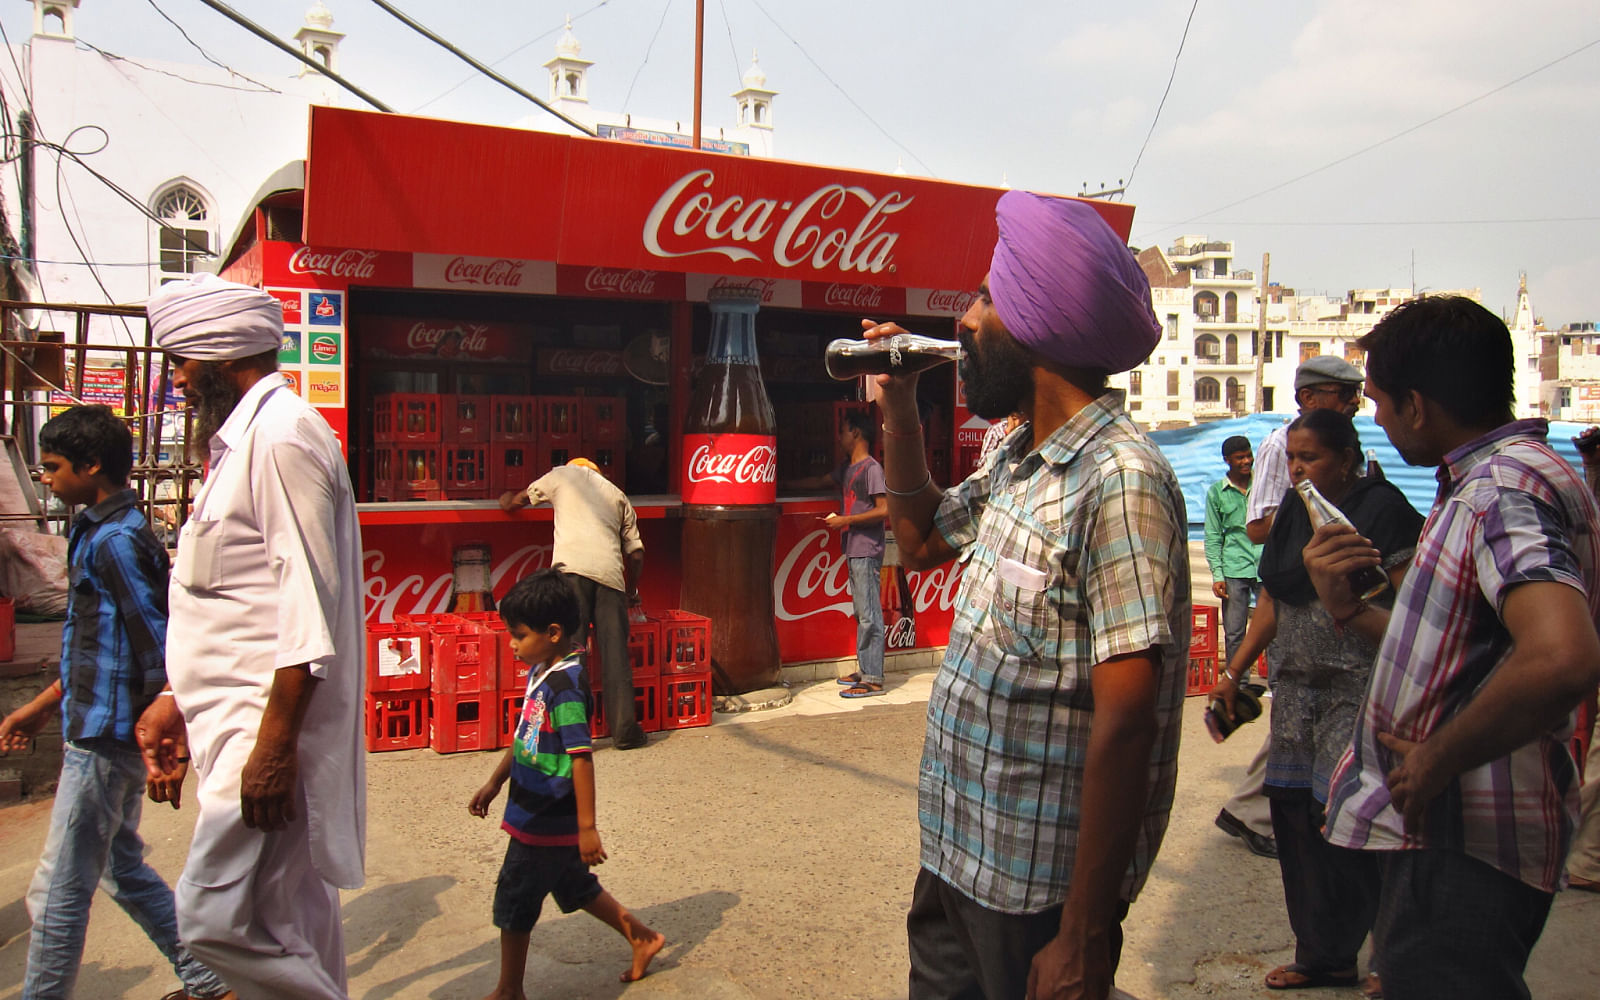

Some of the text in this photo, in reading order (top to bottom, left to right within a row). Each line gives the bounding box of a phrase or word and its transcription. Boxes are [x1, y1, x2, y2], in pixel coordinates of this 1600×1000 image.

[642, 168, 915, 274] Coca-Cola
[288, 246, 379, 279] Coca-Cola
[444, 257, 526, 287] Coca-Cola
[584, 266, 658, 294] Coca-Cola
[824, 282, 883, 308] Coca-Cola
[927, 289, 977, 313] Coca-Col
[407, 321, 489, 352] Cocaola
[688, 444, 777, 484] Coca-Cola
